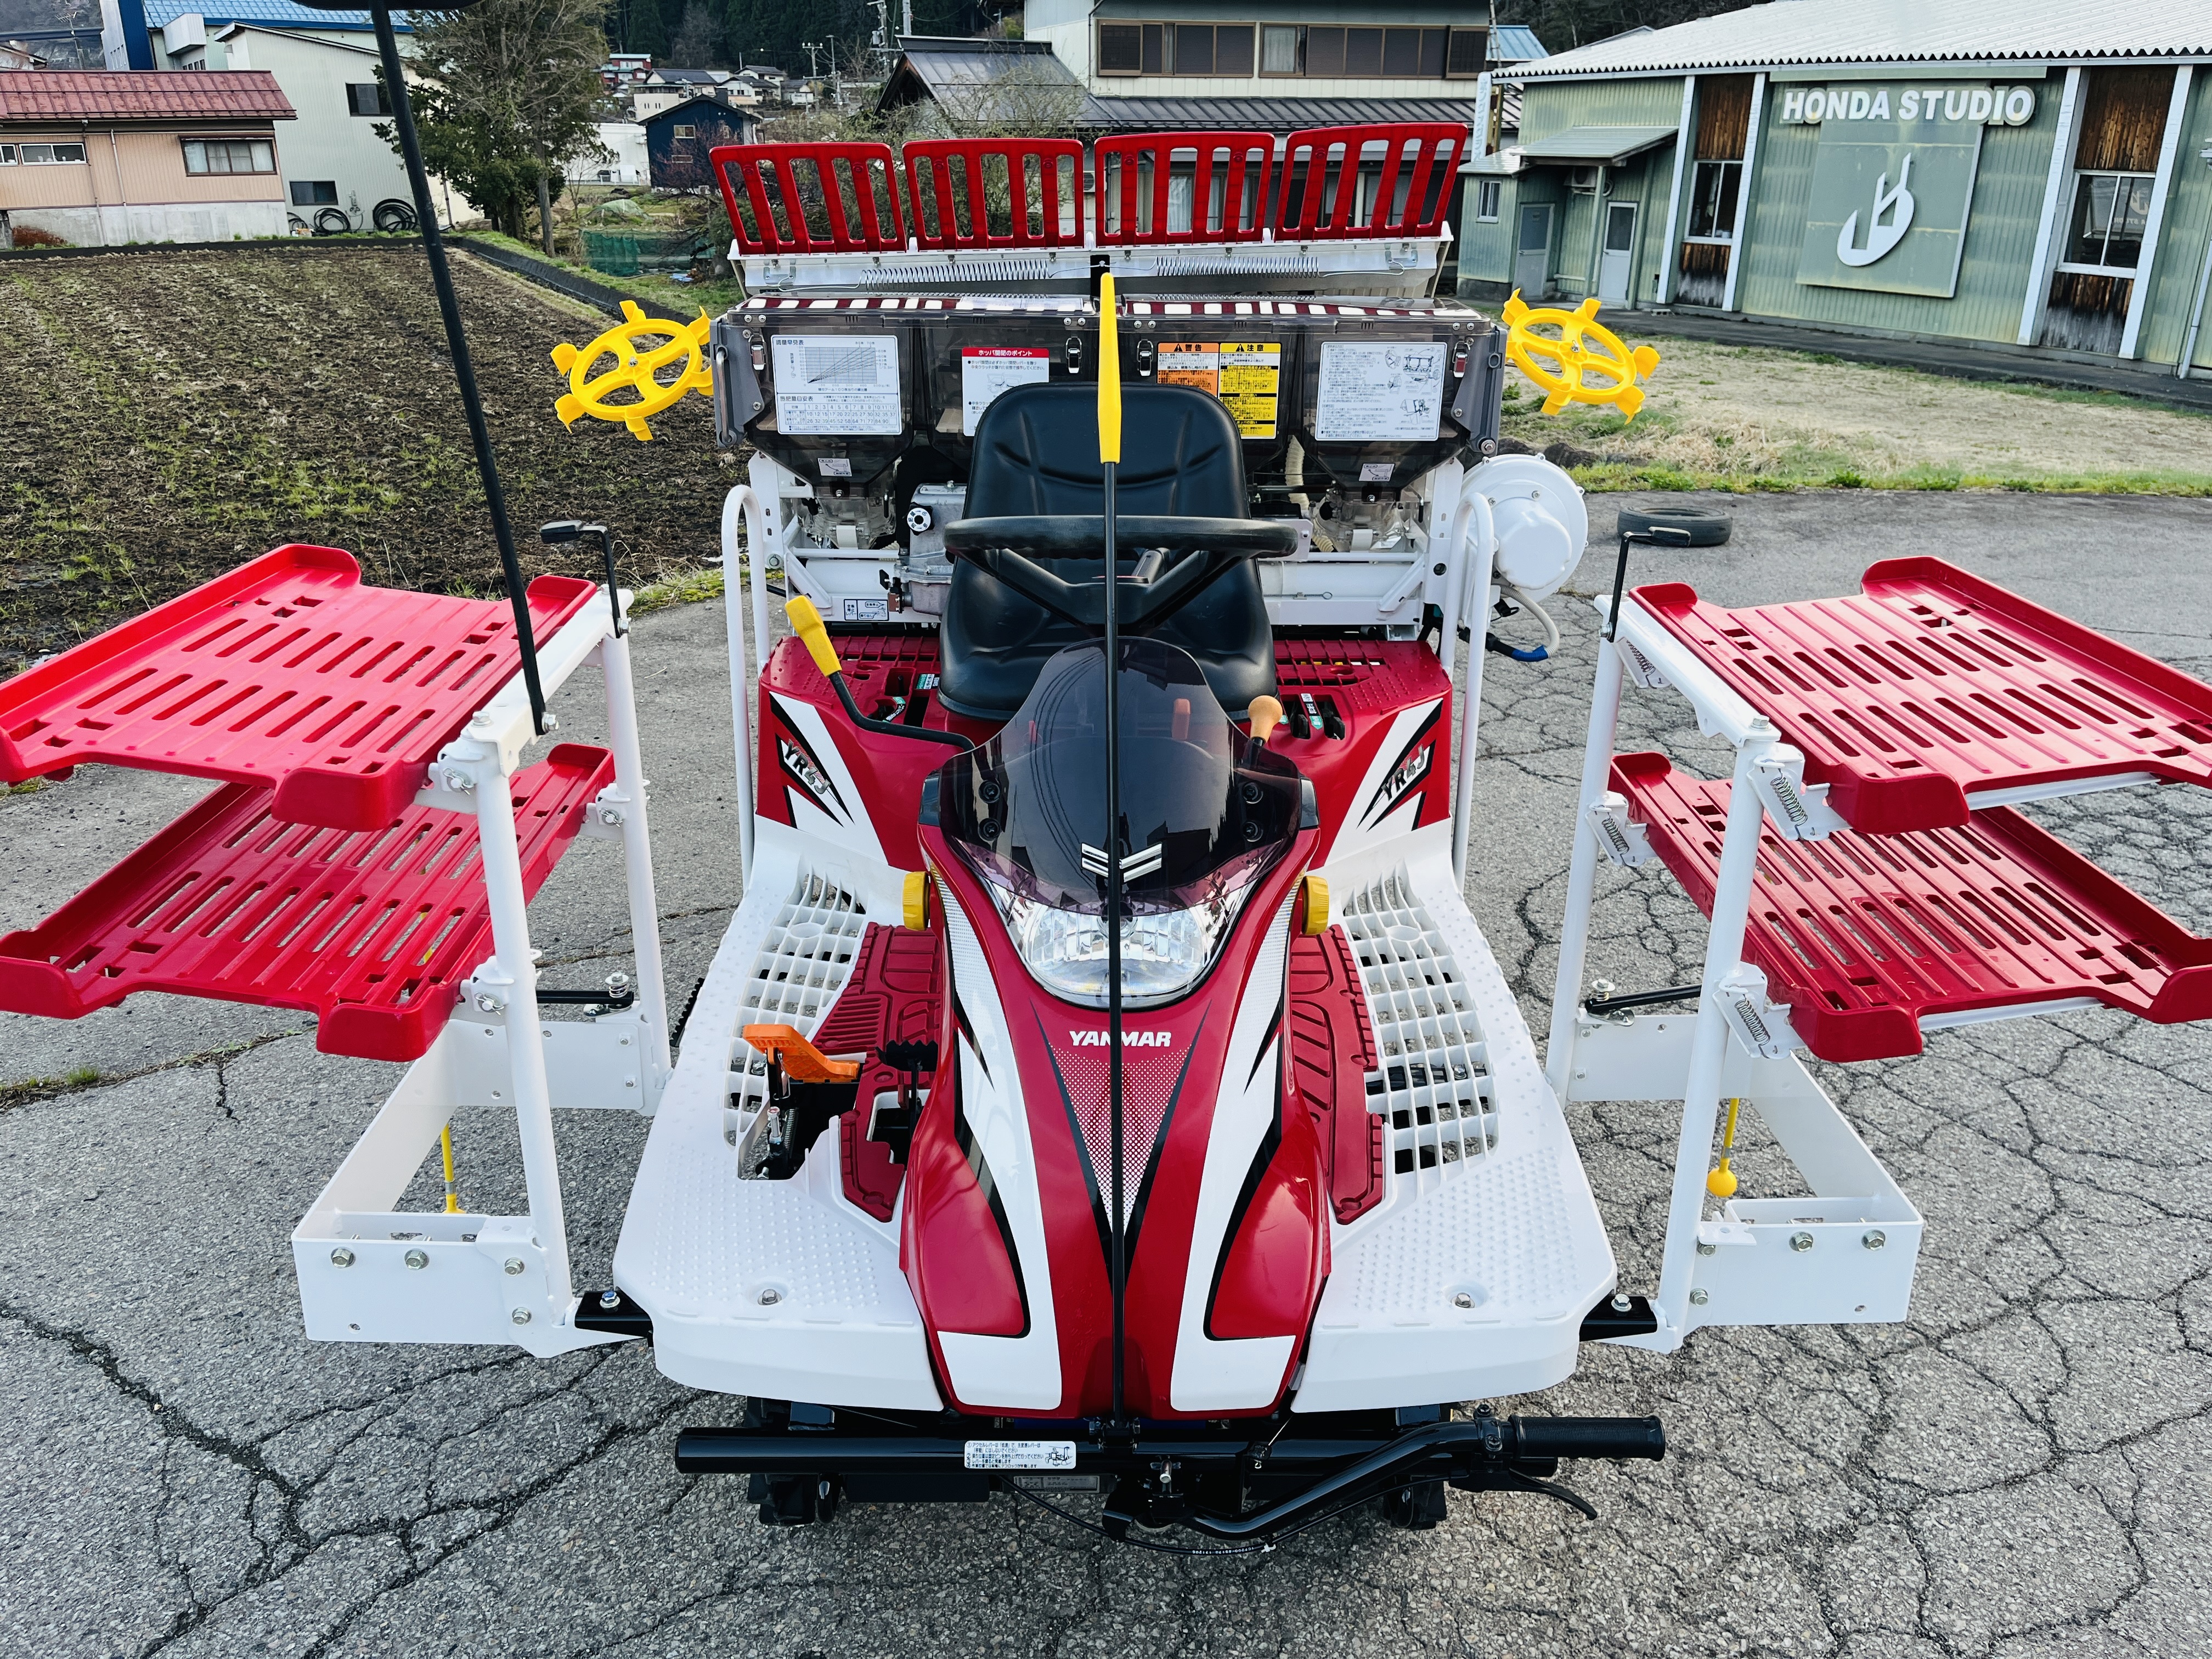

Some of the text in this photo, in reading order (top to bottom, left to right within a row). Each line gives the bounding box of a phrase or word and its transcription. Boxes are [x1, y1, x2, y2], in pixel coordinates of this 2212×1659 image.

[1782, 88, 2033, 124] HONDA STUDIO
[1069, 1031, 1172, 1047] YANMAR
